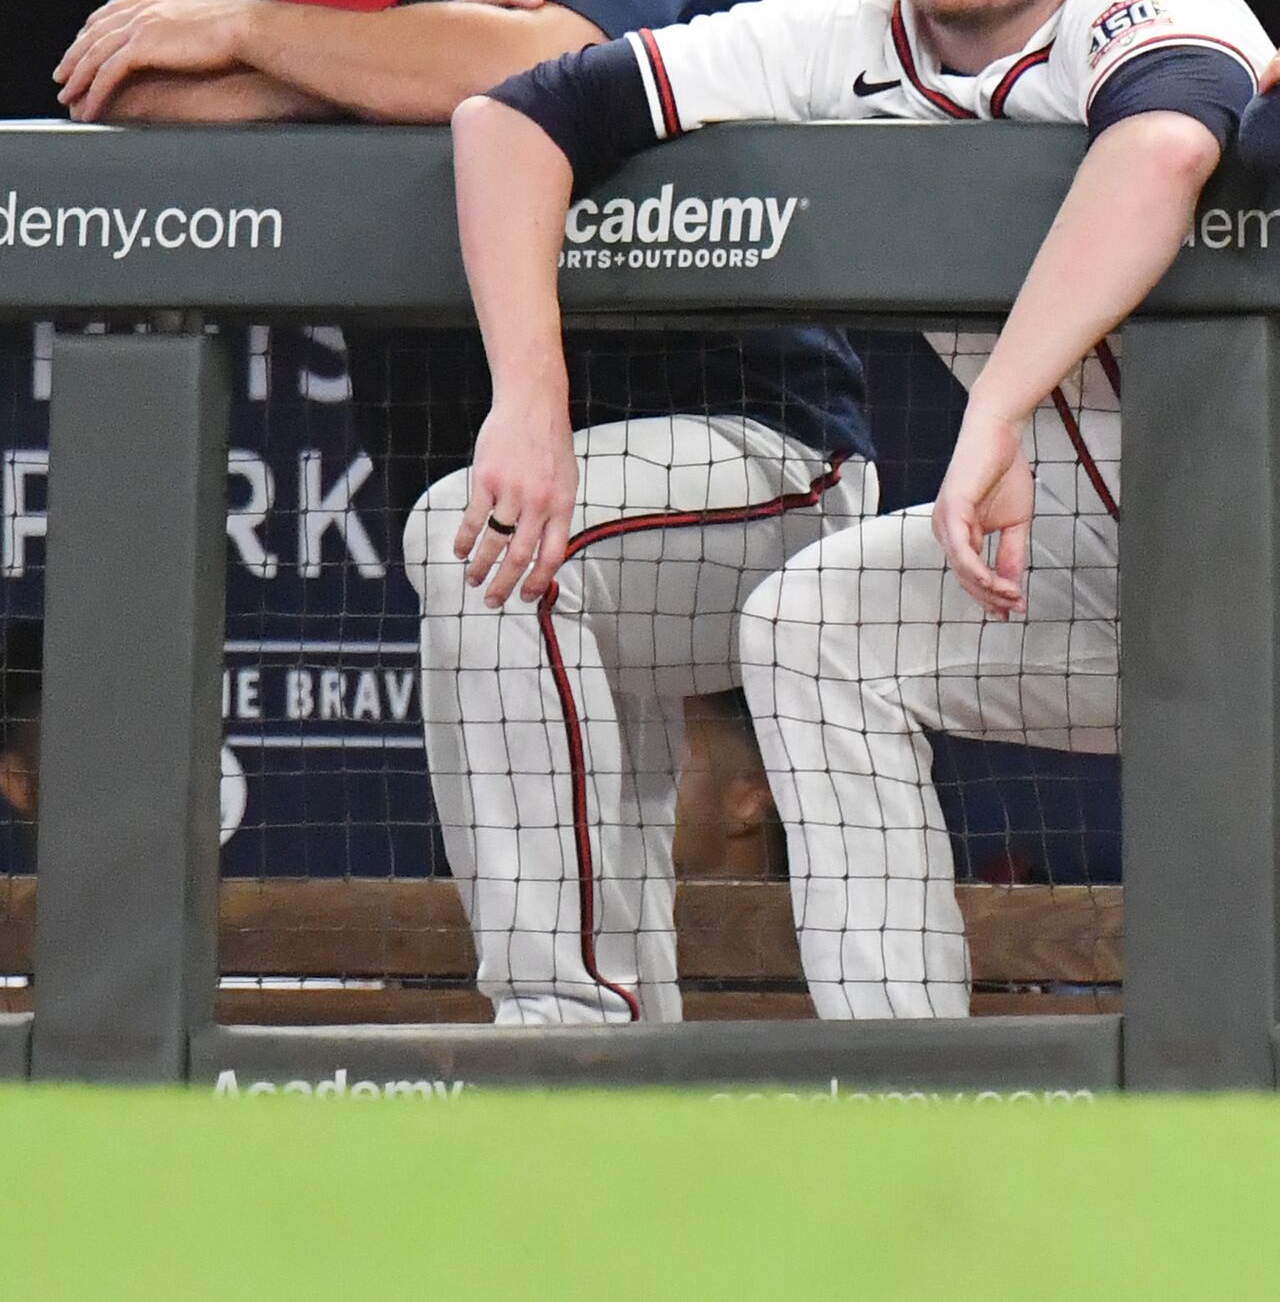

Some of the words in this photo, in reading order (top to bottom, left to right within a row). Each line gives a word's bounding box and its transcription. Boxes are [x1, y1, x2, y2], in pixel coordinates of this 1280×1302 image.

[0, 191, 283, 259] demy.com
[565, 183, 798, 260] cademy
[558, 249, 759, 269] RTS+OUTDOORS
[2, 448, 387, 579] PRK
[286, 669, 415, 721] BRAV
